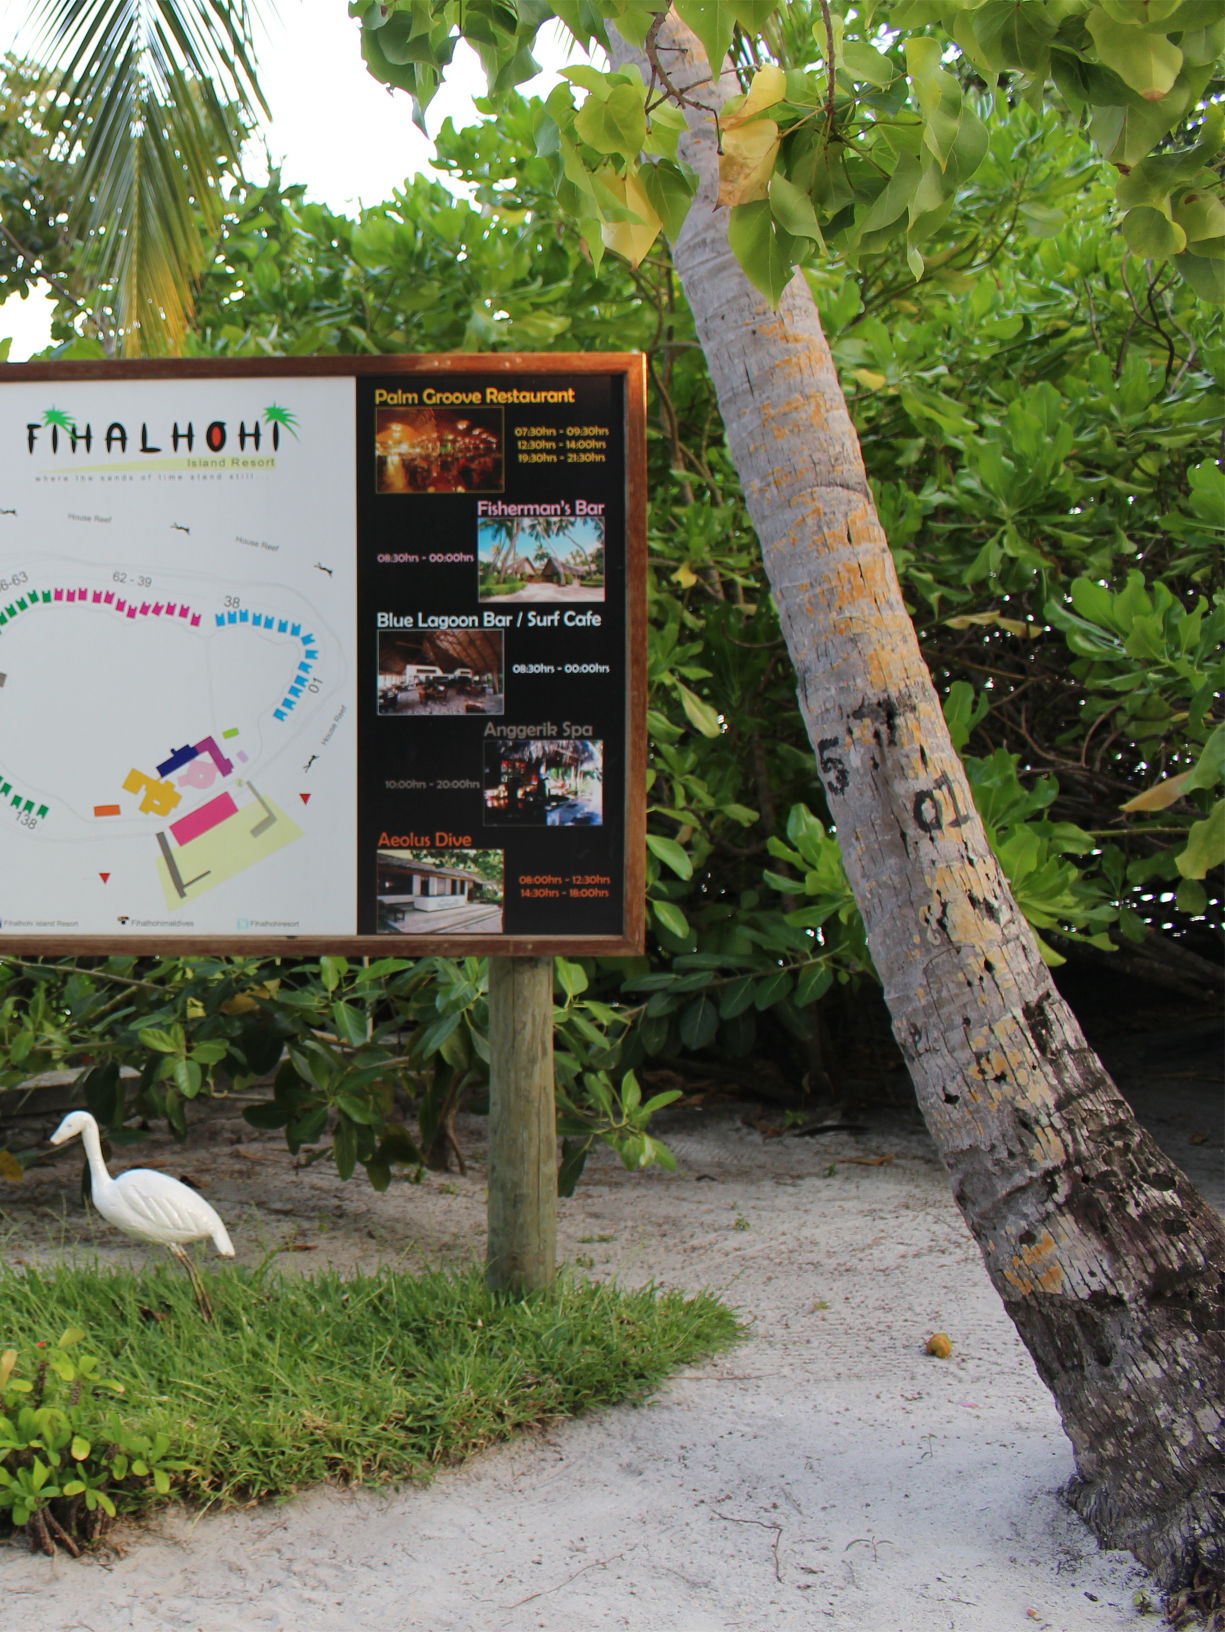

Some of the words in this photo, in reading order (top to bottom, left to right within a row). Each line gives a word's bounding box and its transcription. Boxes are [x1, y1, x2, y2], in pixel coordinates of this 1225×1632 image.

[375, 389, 418, 404] Palm
[422, 388, 482, 404] Groove
[485, 387, 576, 403] Restaurant
[27, 418, 280, 454] FIHALHOHI
[186, 457, 226, 468] Island
[230, 456, 276, 468] Resort
[477, 500, 572, 516] Fisherman's
[575, 500, 605, 515] Bar
[67, 513, 92, 523] House
[93, 515, 112, 524] Reef
[234, 535, 260, 548] House
[260, 542, 280, 552] Reef
[112, 571, 128, 584] 62
[137, 575, 153, 588] 39
[223, 595, 241, 609] 38
[377, 612, 414, 628] Blue
[418, 611, 479, 630] Lagoon
[482, 611, 513, 628] Bar
[527, 610, 561, 627] Surf
[563, 610, 603, 627] Cafe
[308, 677, 324, 694] 01
[321, 722, 338, 746] House
[333, 704, 347, 722] Reef
[484, 721, 558, 739] Anggerik
[563, 721, 593, 738] Spa
[15, 811, 38, 830] 138
[378, 831, 431, 848] Aeolus
[435, 831, 473, 847] Dive
